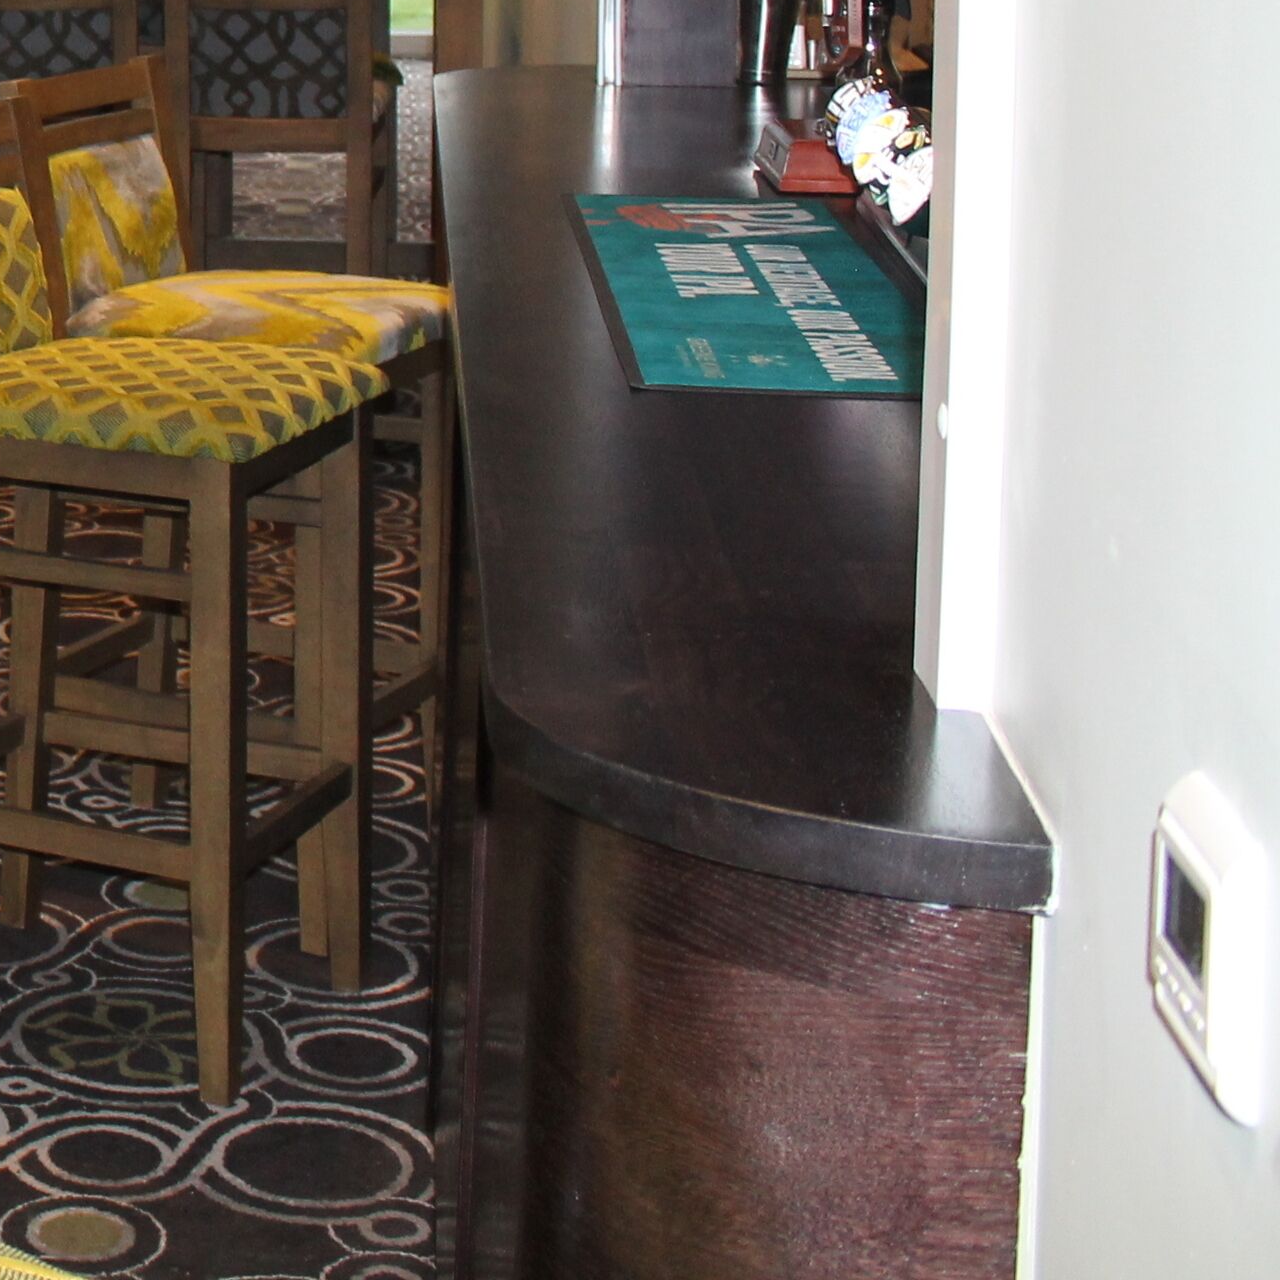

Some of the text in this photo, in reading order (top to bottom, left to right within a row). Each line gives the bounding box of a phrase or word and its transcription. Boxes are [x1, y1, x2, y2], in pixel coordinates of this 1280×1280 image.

[661, 203, 836, 238] IPA
[654, 243, 760, 298] YOUR IPA.
[743, 244, 808, 262] OUR
[787, 309, 860, 331] OUR
[801, 332, 899, 382] PASSION.
